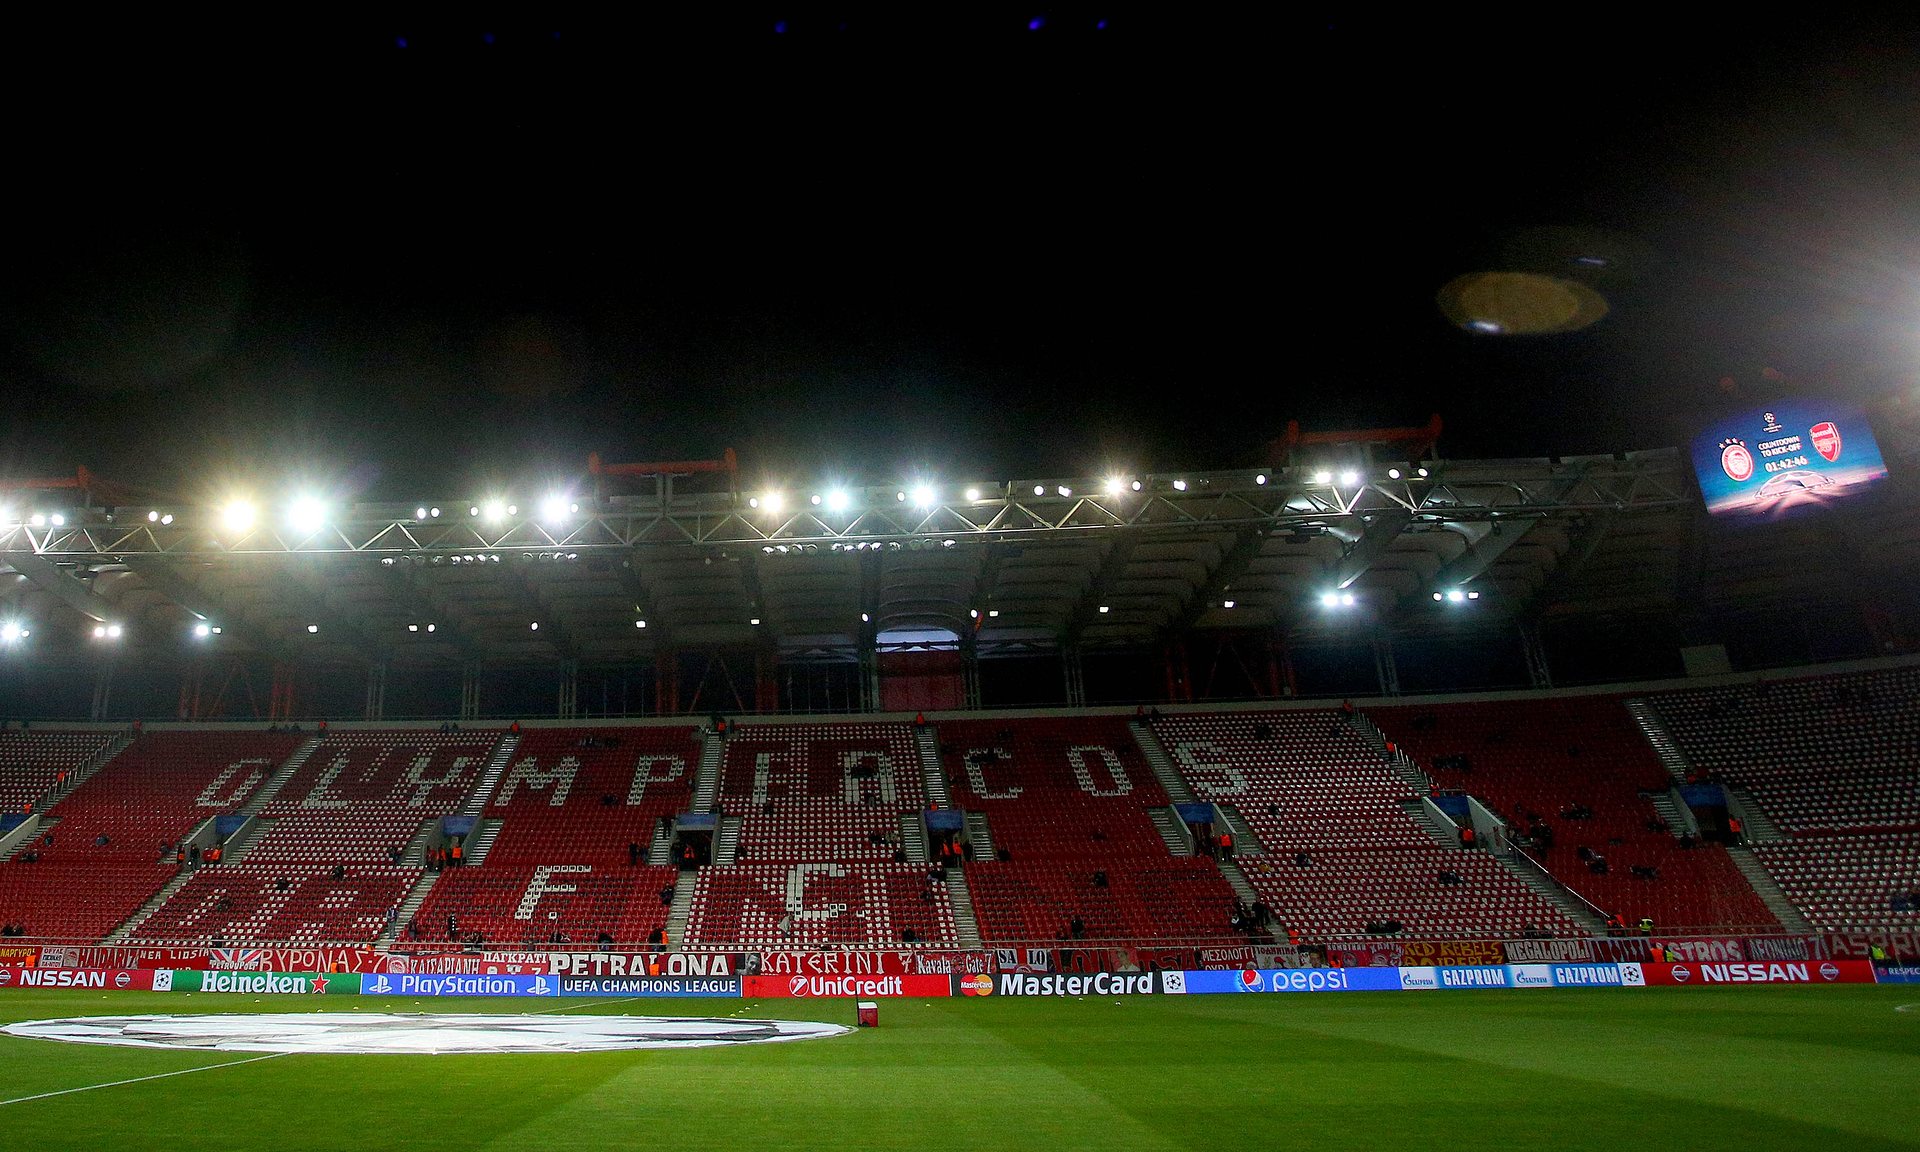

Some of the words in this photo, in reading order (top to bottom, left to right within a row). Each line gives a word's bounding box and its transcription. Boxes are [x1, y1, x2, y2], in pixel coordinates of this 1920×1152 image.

[1758, 436, 1801, 451] COUNTDOWN
[1761, 449, 1772, 458] TO
[1771, 442, 1802, 457] KICK-OFF
[1765, 456, 1808, 473] 01:42:46
[140, 950, 161, 959] NEA
[1405, 942, 1436, 957] RED
[1441, 941, 1502, 957] REBELS
[1658, 941, 1743, 962] STROS
[760, 951, 885, 975] KATERINI
[917, 954, 951, 974] Kavala
[20, 970, 106, 987] NISSAN
[1272, 967, 1349, 991] pepsi
[1442, 968, 1505, 986] GAZPROM
[1555, 966, 1619, 984] GAZPROM
[1701, 963, 1810, 982] NISSAN
[200, 971, 307, 993] Heineken
[401, 975, 516, 996] PlayStation
[564, 980, 599, 992] UEFA
[602, 980, 680, 992] CHAMPIONS
[685, 980, 737, 992] LEAGUE
[810, 976, 903, 996] UniCredit
[1000, 972, 1153, 996] MasterCard
